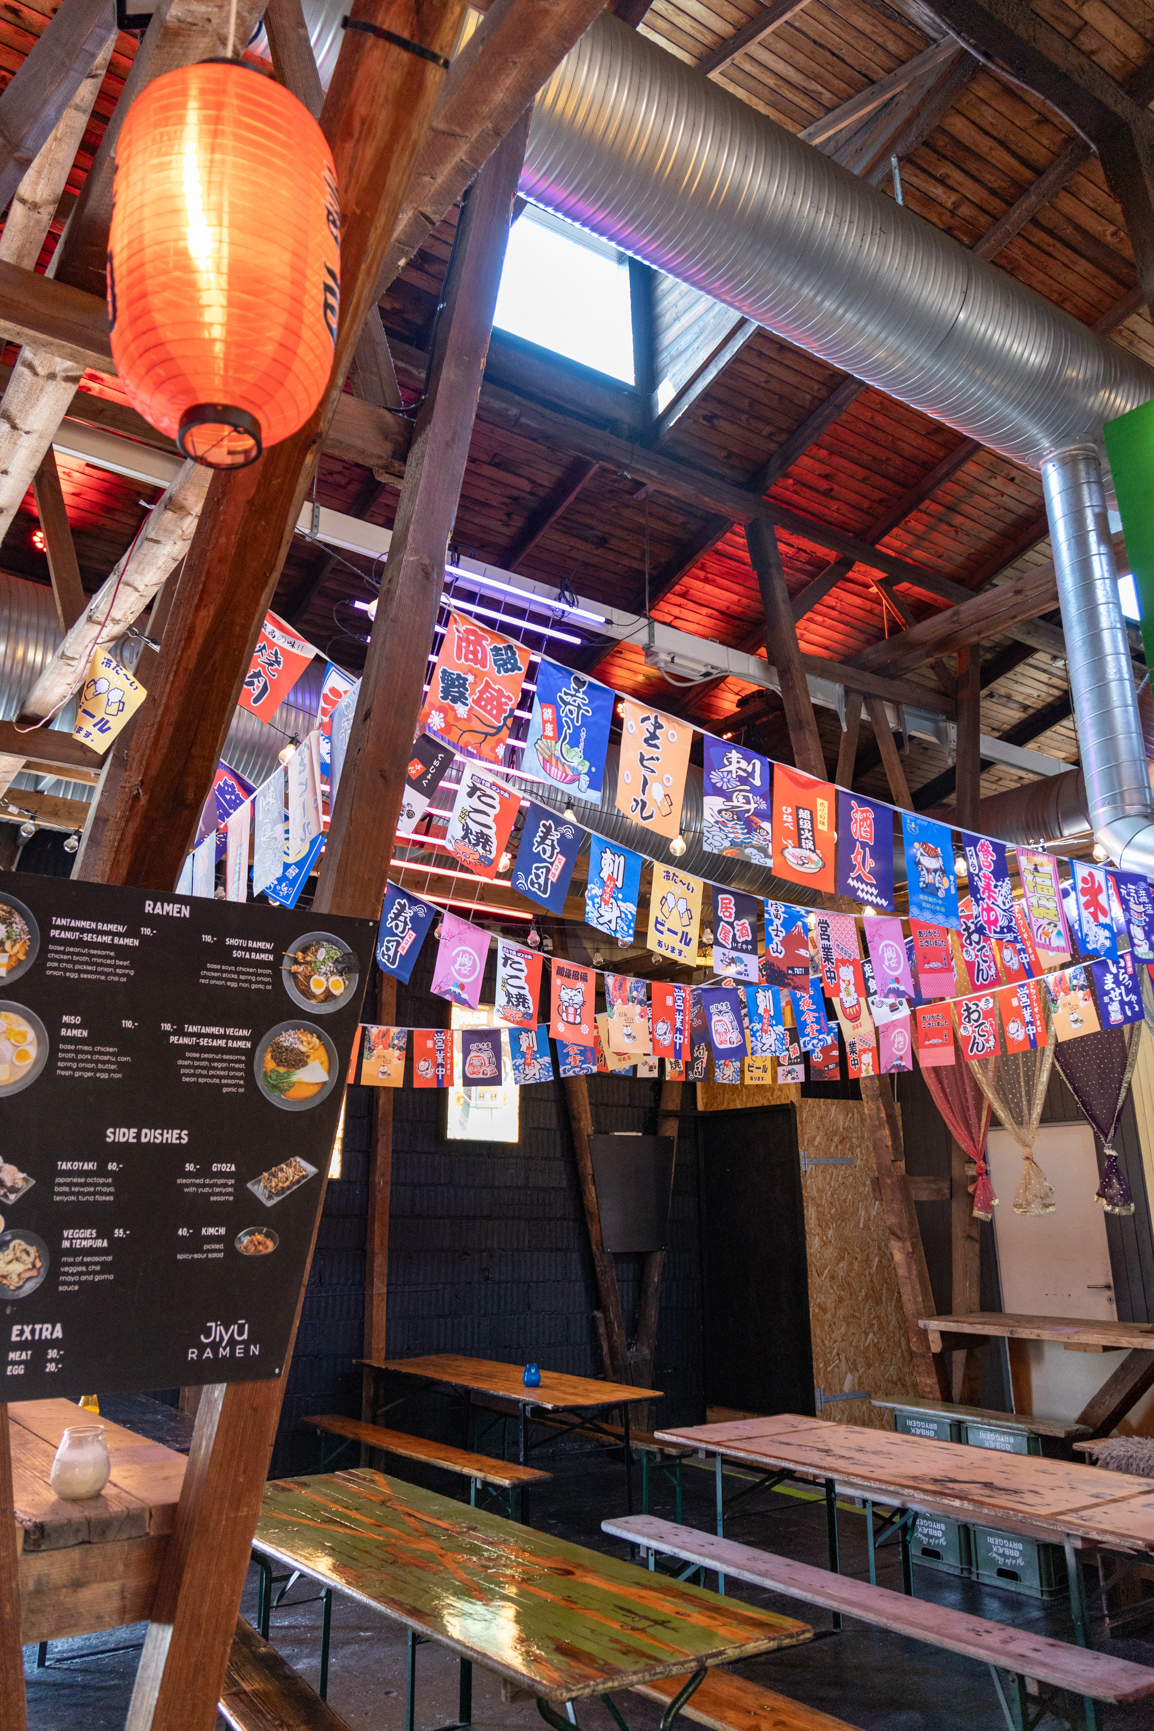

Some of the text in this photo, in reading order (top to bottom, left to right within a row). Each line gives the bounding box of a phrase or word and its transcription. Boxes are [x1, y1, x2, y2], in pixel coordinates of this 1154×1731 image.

[79, 701, 112, 734] ール
[630, 713, 665, 823] 生ビール
[718, 749, 762, 818] 刺身
[461, 781, 496, 856] たこ焼
[596, 846, 626, 932] 刺身
[144, 900, 190, 918] RAMEN
[52, 917, 127, 932] TANTANMEN RAMEN/
[717, 894, 752, 949] 居酒屋
[768, 899, 785, 959] 富士山
[50, 930, 139, 946] PEANUT-SESAME RAMEN
[140, 927, 157, 936] 110,-
[654, 915, 692, 948] ビール
[917, 929, 941, 938] ありがとう
[202, 934, 274, 950] 110,- SHOYU RAMEN/
[232, 950, 274, 961] SOYA RAMEN
[818, 918, 838, 987] 営業中
[960, 918, 990, 985] おでん
[501, 953, 531, 1010] たこ焼
[62, 1015, 81, 1024] MISO
[673, 987, 686, 1050] 営業中
[755, 987, 777, 1053] 刺身
[796, 991, 820, 1038] 夜食堂
[922, 1013, 944, 1021] ありがとう
[1017, 986, 1037, 1040] 営業中
[122, 1020, 138, 1029] 110,-
[161, 1023, 252, 1036] 110,- TANTANMEN VEGAN/
[961, 1000, 989, 1056] おでん
[61, 1028, 88, 1038] RAMEN
[169, 1036, 251, 1048] PEANUT-SESAME RAMEN
[433, 1032, 446, 1080] 営業中
[518, 1030, 542, 1081] 刺身
[747, 1062, 769, 1074] ビール
[106, 1128, 189, 1144] SIDE DISHES
[57, 1161, 97, 1170] TAKOYAKI
[107, 1162, 123, 1171] 60,-
[185, 1163, 236, 1172] 50,- GYOZA
[63, 1229, 97, 1238] VEGGIES
[114, 1228, 130, 1238] 55,-
[178, 1227, 226, 1236] 40,- KIMCHI
[61, 1239, 108, 1248] IN TEMPURA
[11, 1323, 63, 1341] EXTRA
[200, 1320, 248, 1346] Jiyū
[8, 1350, 32, 1361] MEAT
[47, 1349, 64, 1359] 30,-
[188, 1344, 259, 1360] RAMEN
[7, 1365, 25, 1375] EGG
[45, 1362, 62, 1373] 20,-
[906, 1419, 938, 1430] BRYGGERI
[979, 1432, 1014, 1443] BRYGGERI
[987, 1536, 1023, 1550] BRYGGERI
